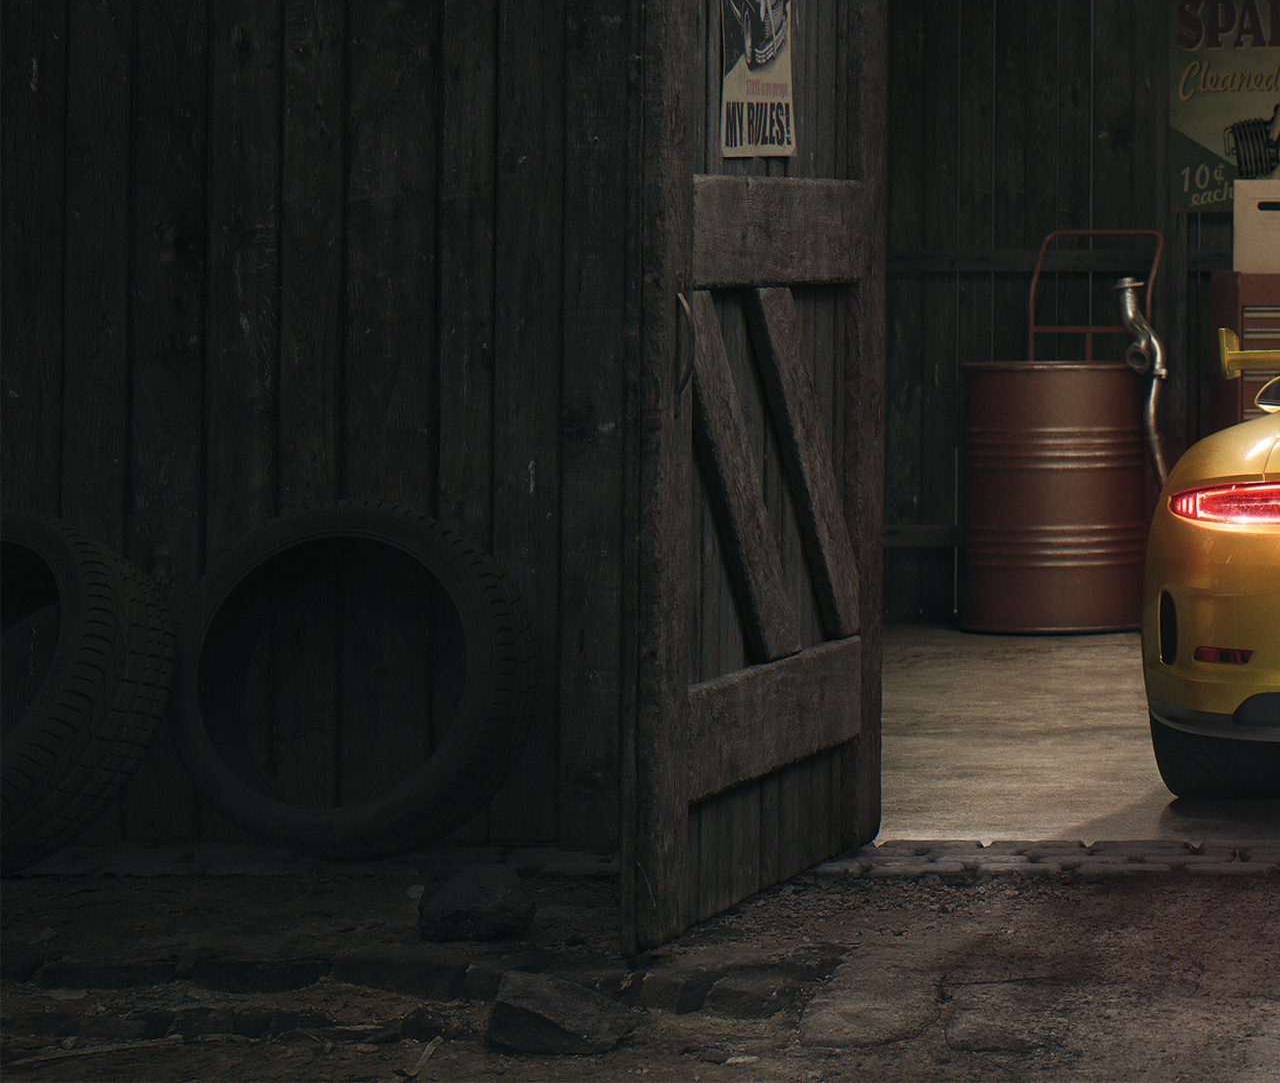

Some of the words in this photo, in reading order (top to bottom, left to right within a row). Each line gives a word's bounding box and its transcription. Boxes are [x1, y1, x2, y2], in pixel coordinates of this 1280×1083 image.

[725, 101, 744, 148] MY
[747, 101, 792, 147] RULES!
[1190, 180, 1234, 207] each
